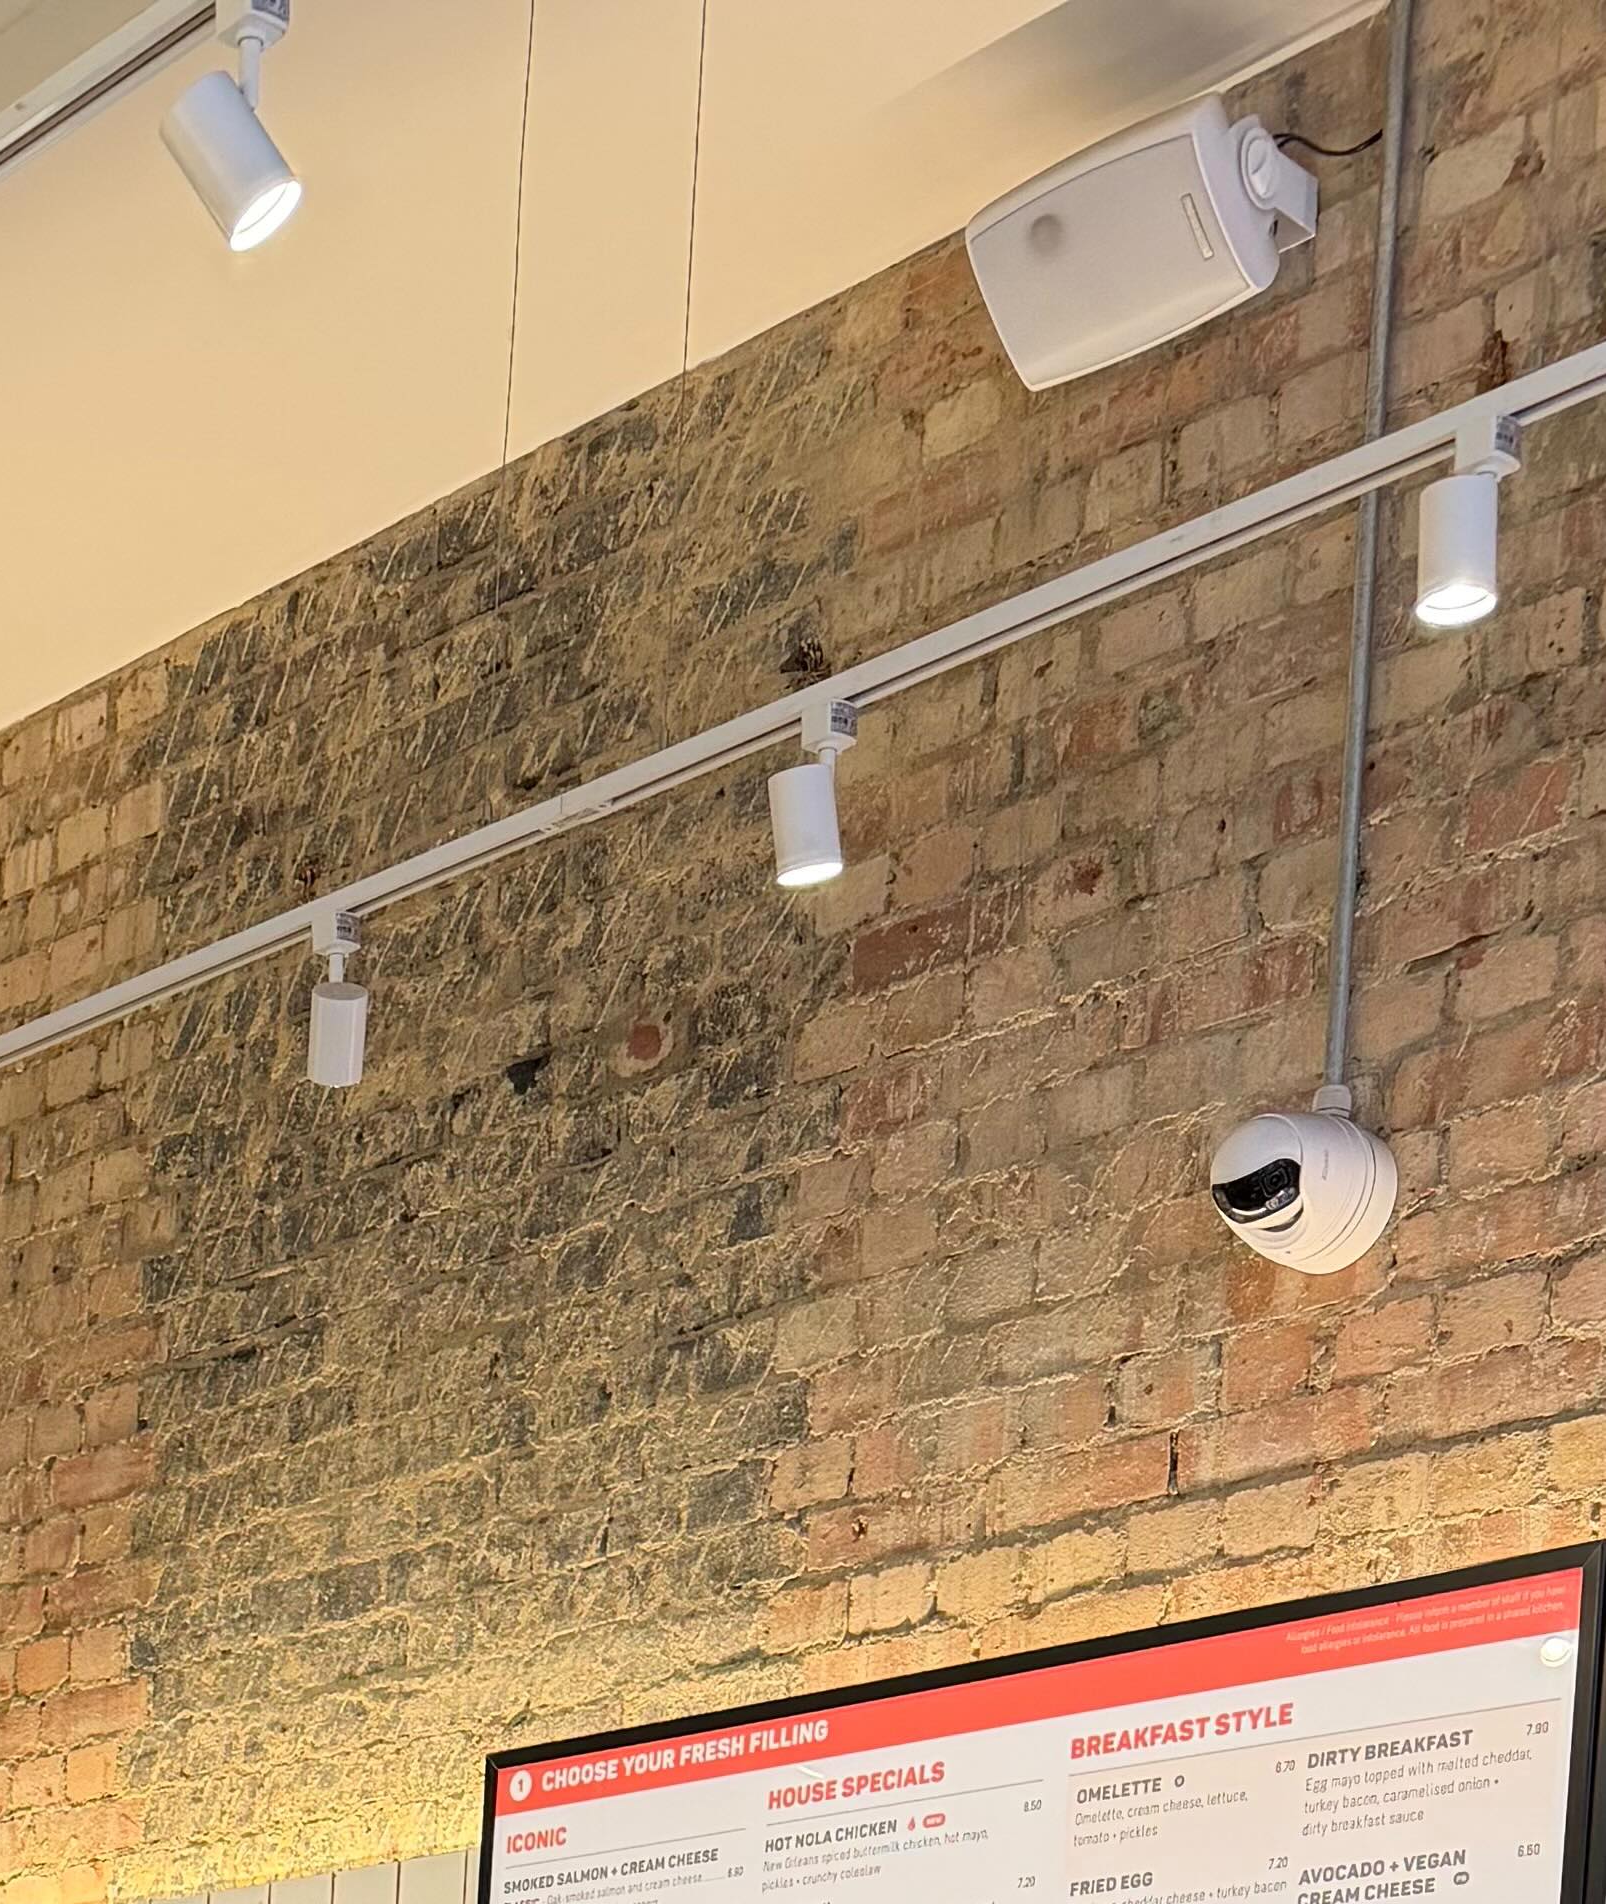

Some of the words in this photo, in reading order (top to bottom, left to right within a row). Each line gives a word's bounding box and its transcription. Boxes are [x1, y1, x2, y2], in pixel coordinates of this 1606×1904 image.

[1069, 1715, 1211, 1760] BREAKFAST
[1213, 1701, 1293, 1736] STYLE
[1306, 1745, 1362, 1769] DIRTY
[1363, 1728, 1473, 1760] BREAKFAST
[541, 1758, 619, 1791] CHOOSE
[621, 1747, 675, 1776] YOUR
[678, 1733, 745, 1766] FRESH
[748, 1718, 829, 1753] FILLING
[767, 1779, 837, 1810] HOUSE
[840, 1760, 945, 1798] SPECIALS
[1075, 1776, 1162, 1804] OMELETTE
[1126, 1803, 1160, 1818] cream
[1162, 1796, 1204, 1813] cheese,
[505, 1825, 567, 1854] ICONIC
[764, 1835, 793, 1853] HOT
[794, 1829, 832, 1848] NOLA
[834, 1818, 897, 1842] CHICKEN
[503, 1874, 554, 1894] SMOKED
[556, 1865, 608, 1886] SALMON
[620, 1855, 665, 1876] CREAM
[667, 1847, 719, 1868] CHEESE
[1069, 1876, 1117, 1897] FRIED
[1120, 1871, 1153, 1890] EGG
[1297, 1859, 1385, 1886] AVOCADO
[1402, 1848, 1466, 1872] VEGAN
[1363, 1876, 1435, 1901] CHEESE
